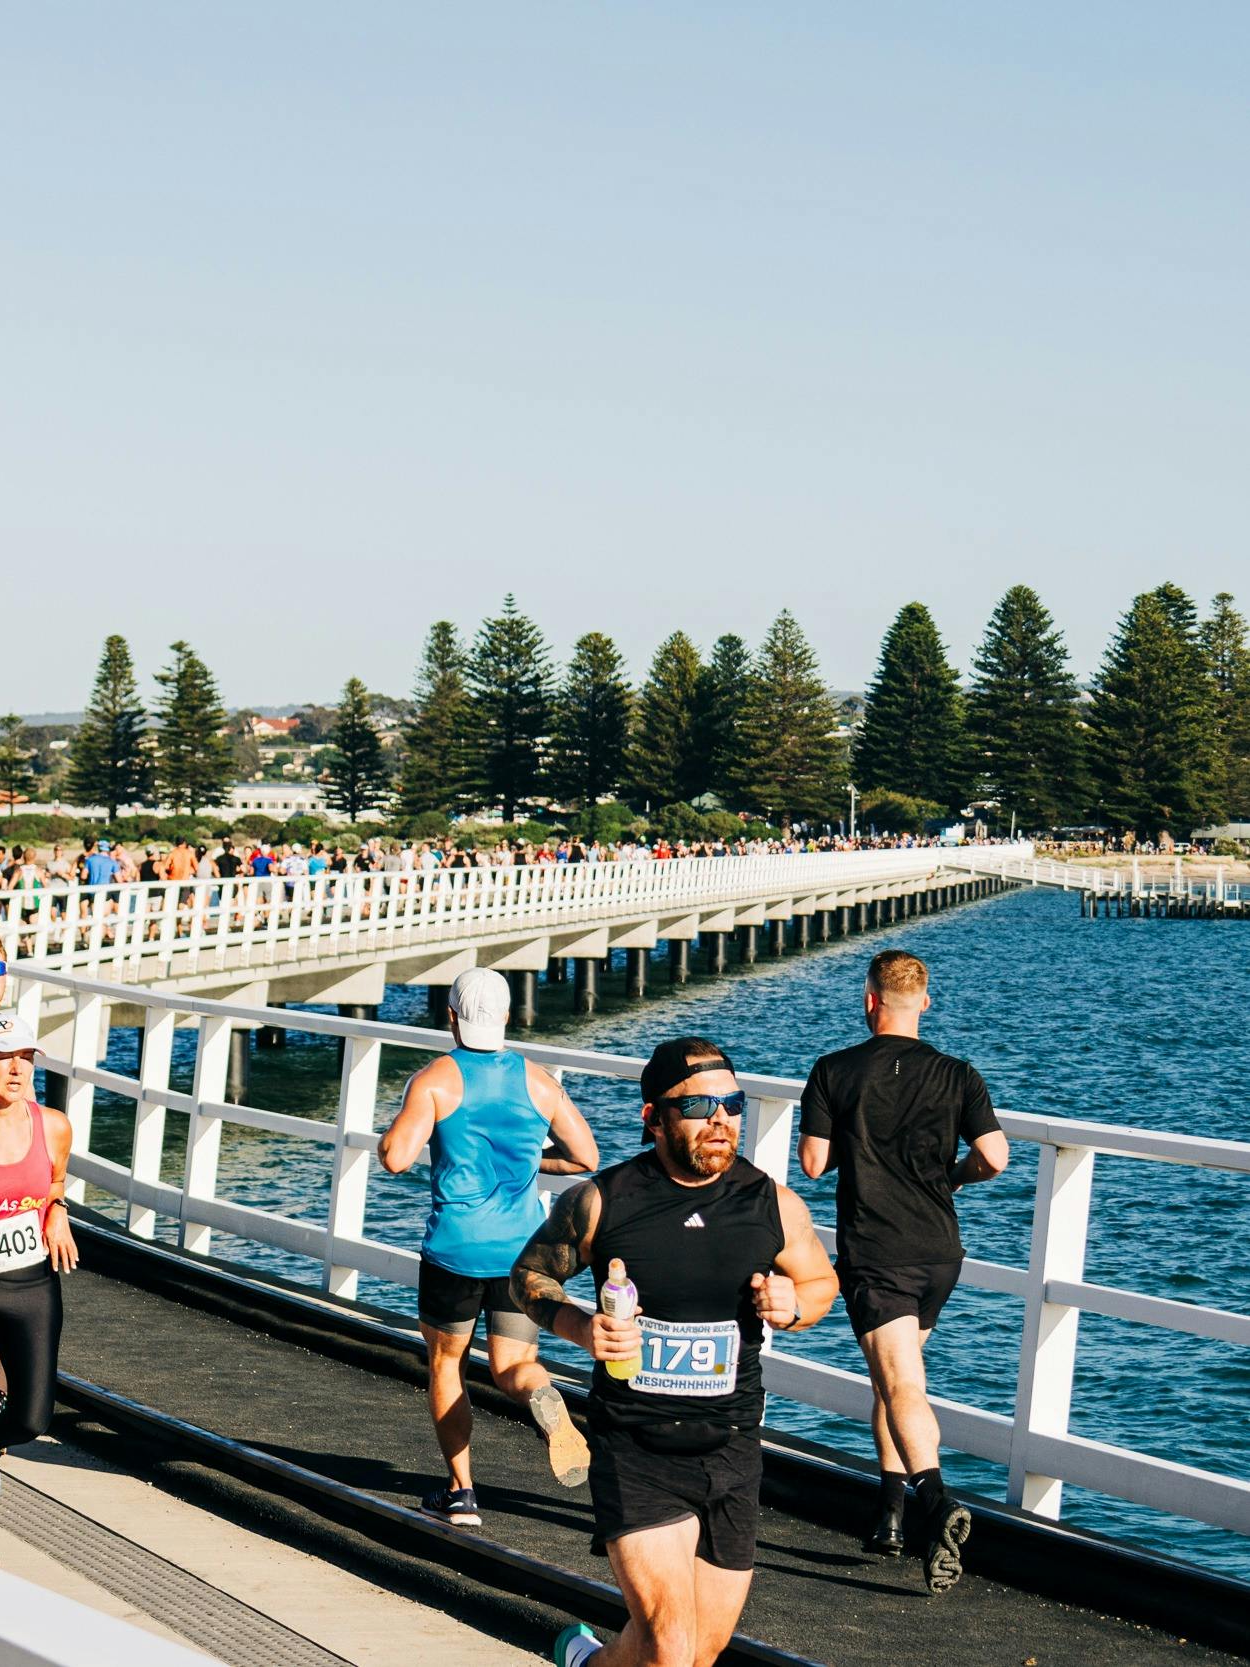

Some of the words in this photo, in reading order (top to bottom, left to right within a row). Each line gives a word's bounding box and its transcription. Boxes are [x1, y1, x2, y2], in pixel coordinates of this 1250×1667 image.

[638, 1319, 670, 1332] VICTOR
[672, 1324, 711, 1333] HARBOR
[647, 1336, 717, 1373] 179
